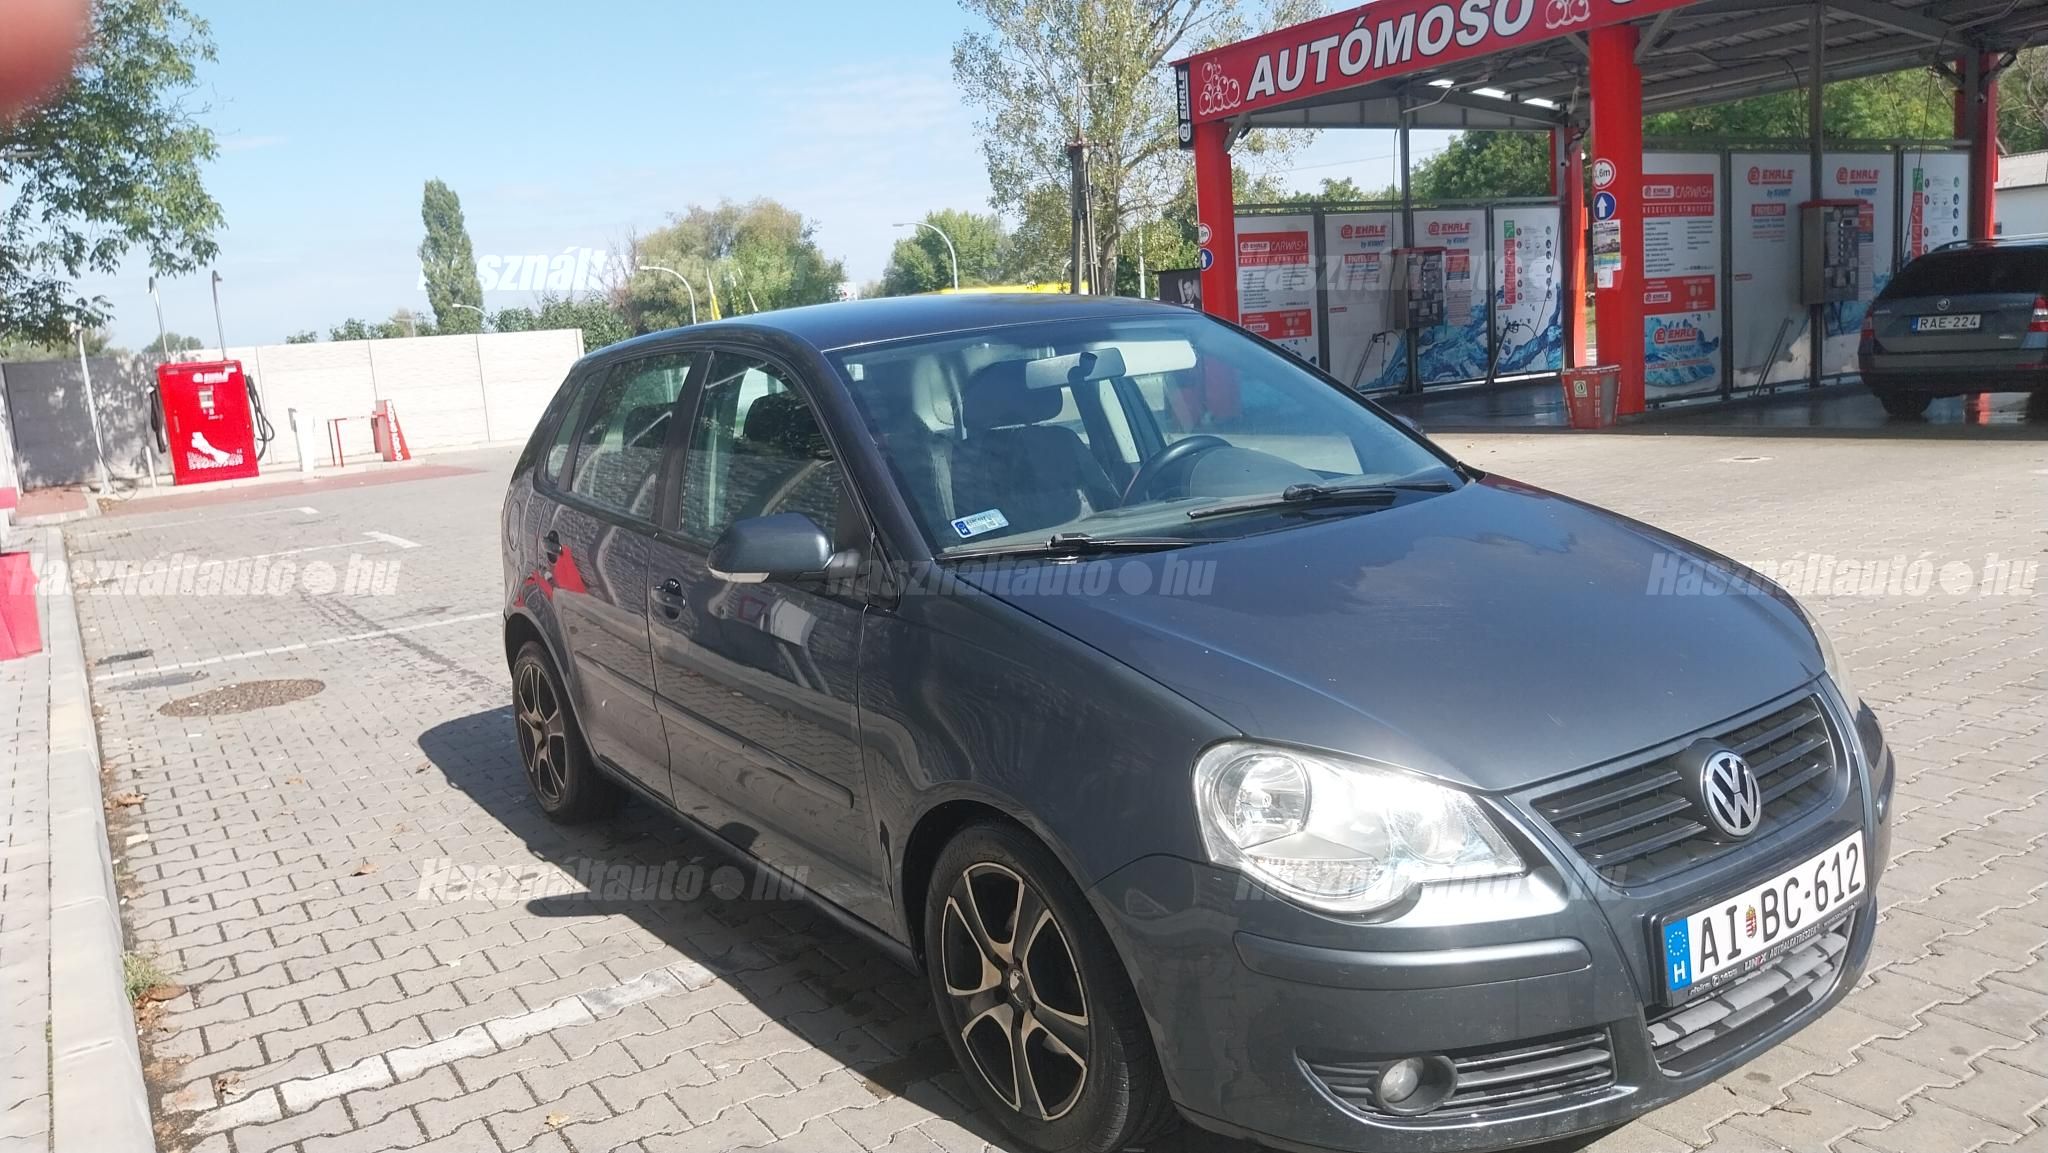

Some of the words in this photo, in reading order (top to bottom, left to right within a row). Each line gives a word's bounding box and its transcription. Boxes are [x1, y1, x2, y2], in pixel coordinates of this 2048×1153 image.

[1178, 70, 1186, 119] EHRLE
[1762, 169, 1794, 180] EHRLE
[1849, 169, 1880, 180] EHRLE
[1354, 225, 1386, 235] EHRLE
[1441, 222, 1472, 232] EHRLE
[1270, 239, 1308, 251] CARWASH
[1919, 316, 1978, 329] RAE-224
[1668, 328, 1697, 339] EHRLE
[1760, 842, 1861, 943] BC-612
[1699, 905, 1742, 974] AI
[1673, 960, 1687, 983] H
